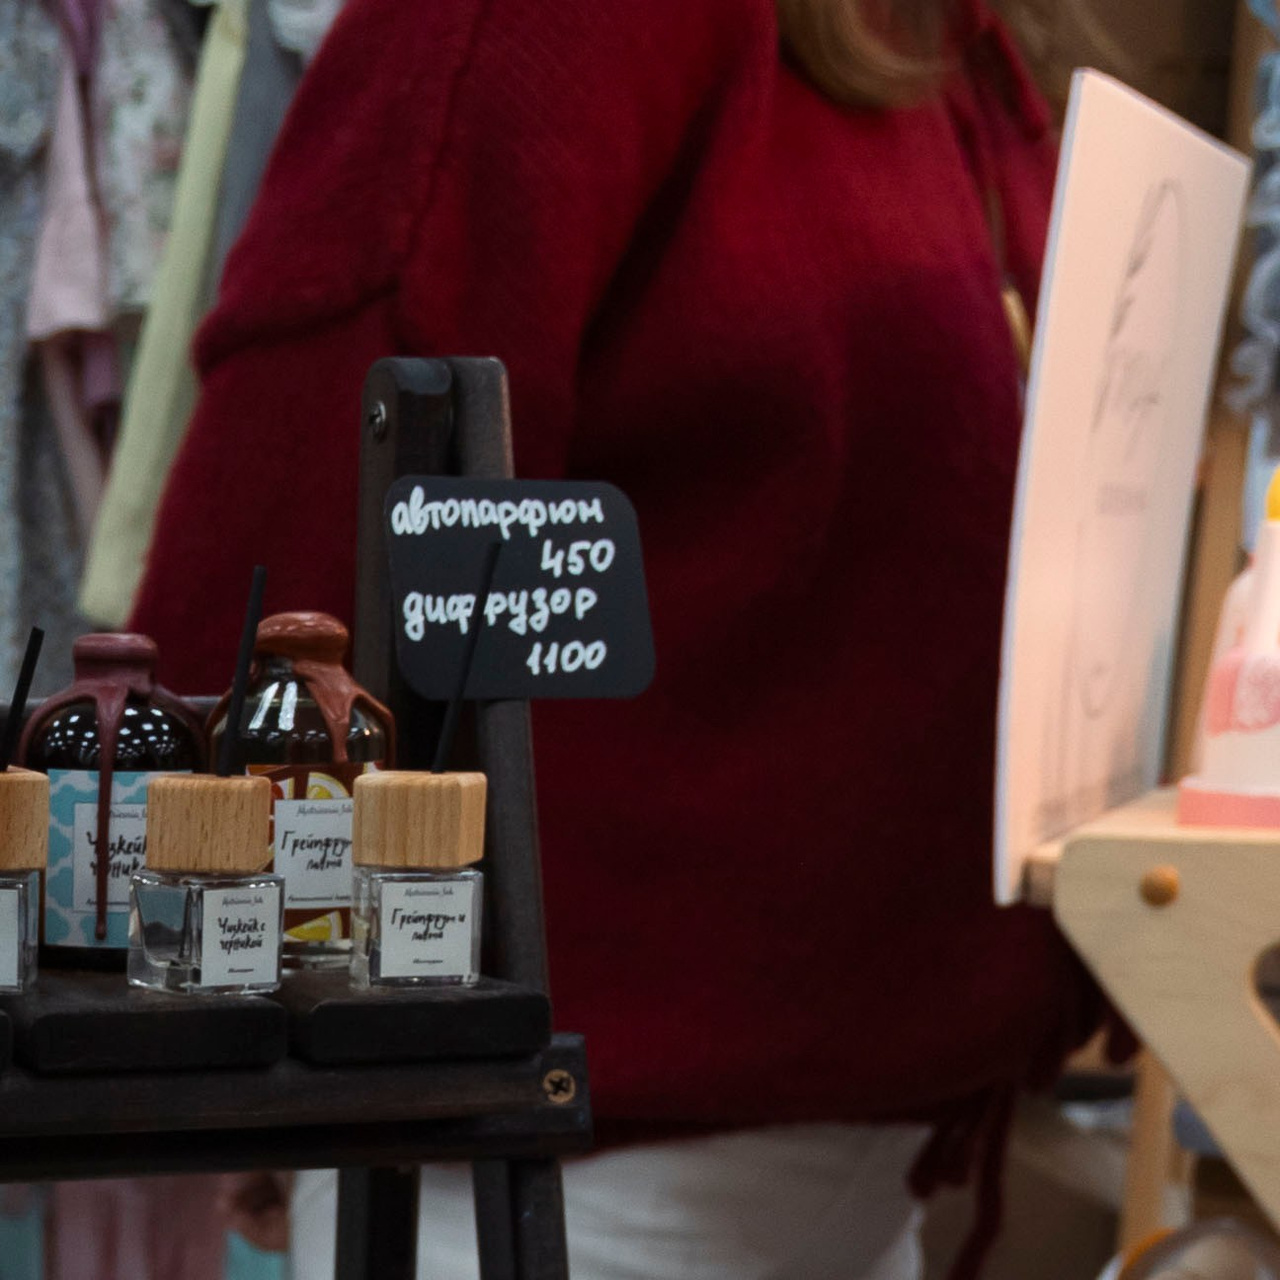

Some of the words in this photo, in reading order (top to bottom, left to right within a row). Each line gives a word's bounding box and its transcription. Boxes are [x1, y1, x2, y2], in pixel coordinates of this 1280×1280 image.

[392, 486, 604, 540] автопарфюм
[541, 539, 615, 577] 450
[527, 641, 607, 675] 1100
